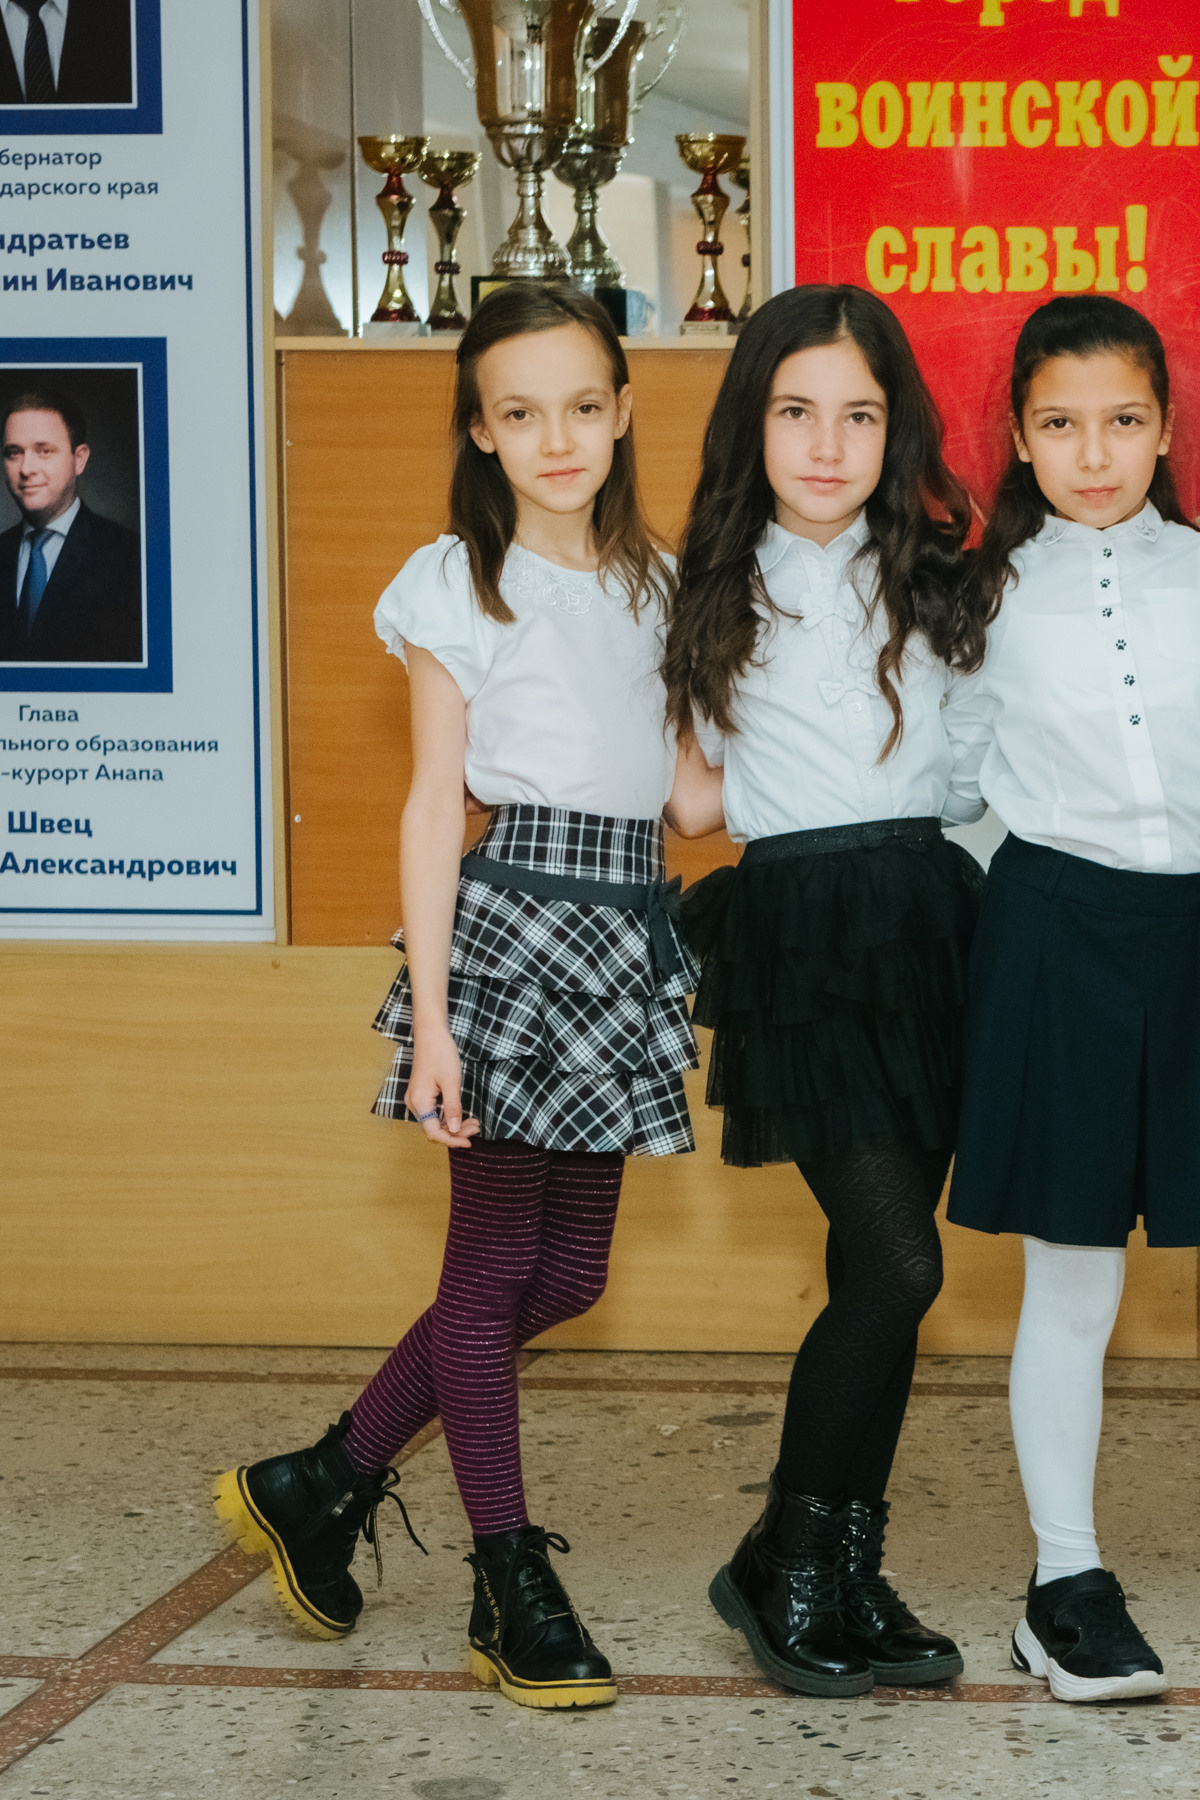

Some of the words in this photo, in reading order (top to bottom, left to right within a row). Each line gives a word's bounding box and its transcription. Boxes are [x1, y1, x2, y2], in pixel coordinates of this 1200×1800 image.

[816, 55, 1199, 148] воинской
[0, 149, 101, 170] бернатор
[0, 182, 100, 200] дарского
[108, 182, 158, 199] края
[866, 205, 1147, 293] славы!
[0, 275, 37, 291] ин
[47, 268, 192, 291] Иванович
[20, 705, 79, 721] Глава
[76, 735, 218, 756] образования
[96, 764, 163, 780] Анапа
[8, 811, 92, 837] Швец
[0, 852, 236, 881] Александрович
